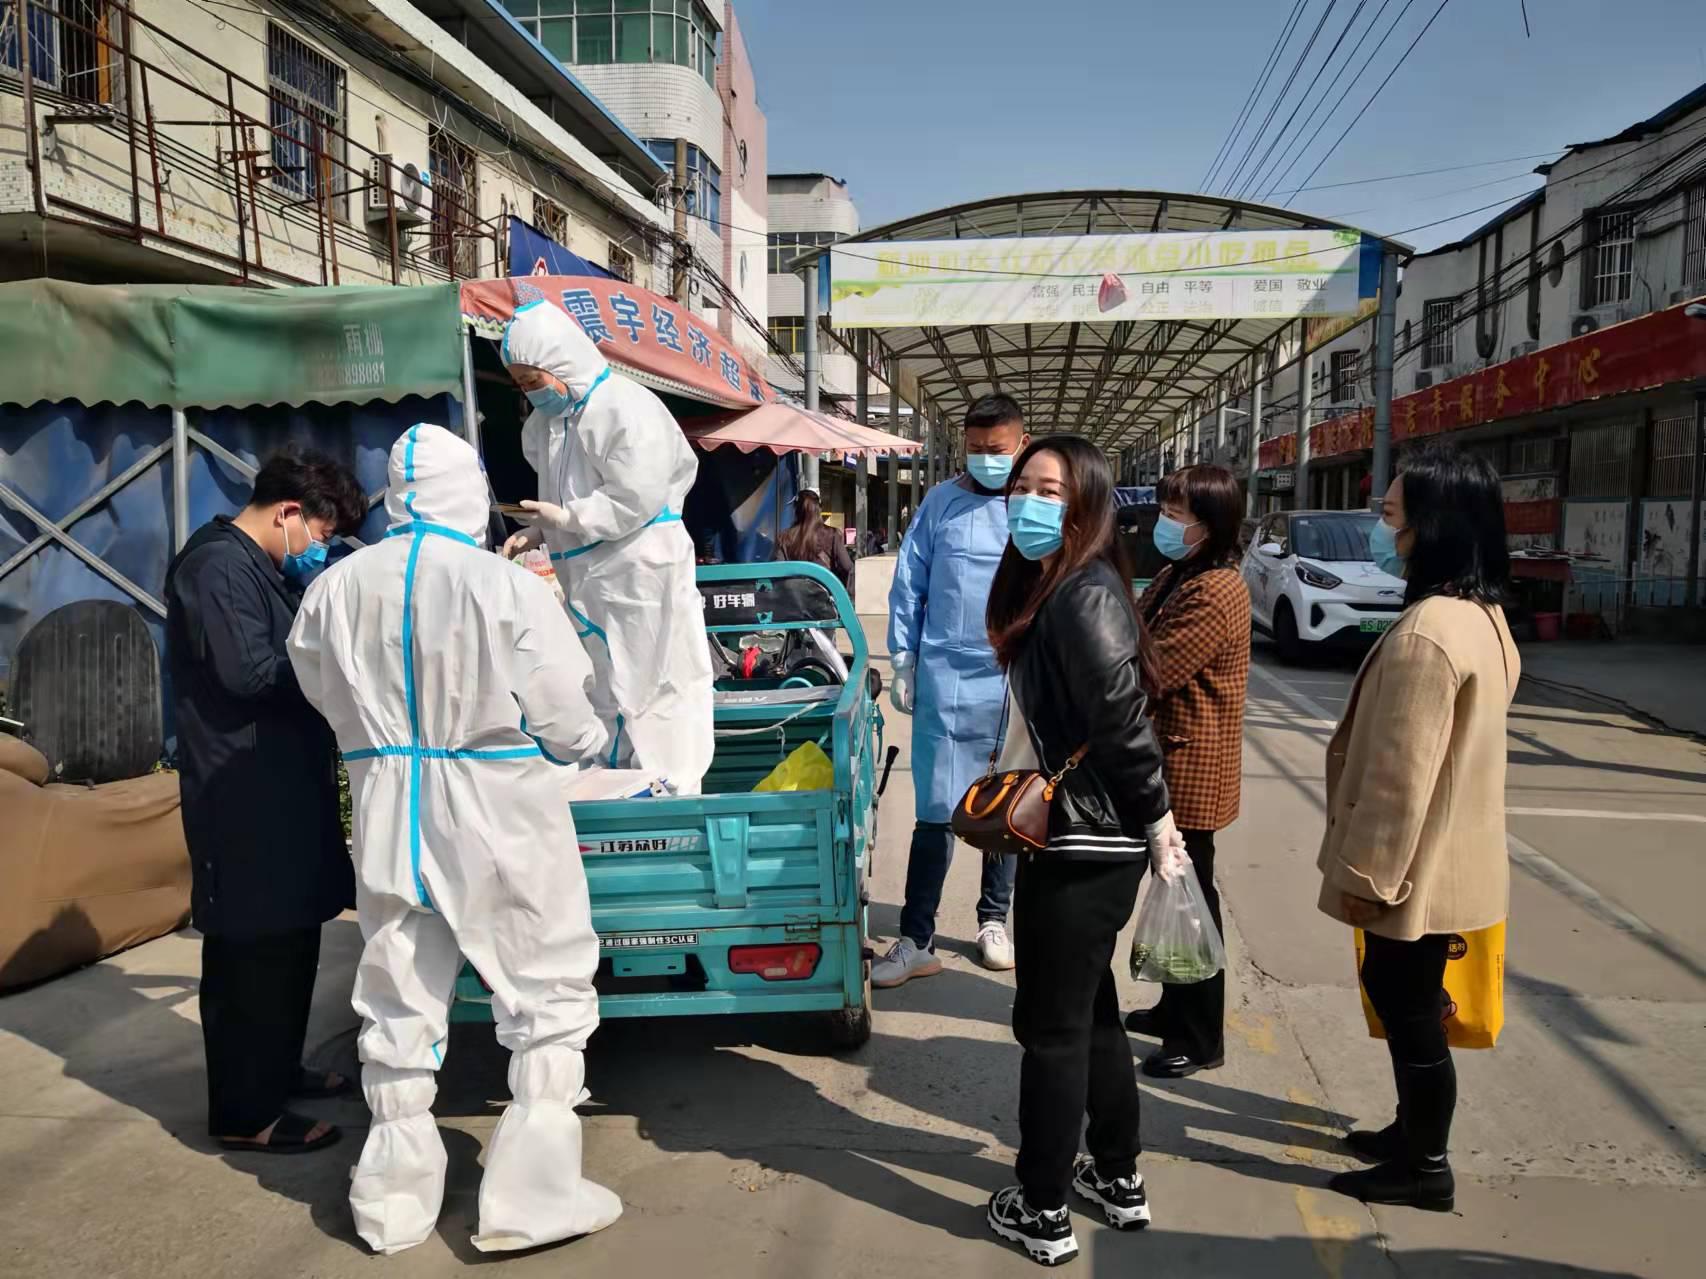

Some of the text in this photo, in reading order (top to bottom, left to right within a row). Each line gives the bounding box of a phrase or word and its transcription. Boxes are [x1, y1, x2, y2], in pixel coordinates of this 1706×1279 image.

[1072, 283, 1097, 296] 民主
[1142, 281, 1169, 294] 自由
[1184, 280, 1214, 294] 平等
[1254, 279, 1282, 292] 爱国
[1296, 278, 1328, 291] 敬业
